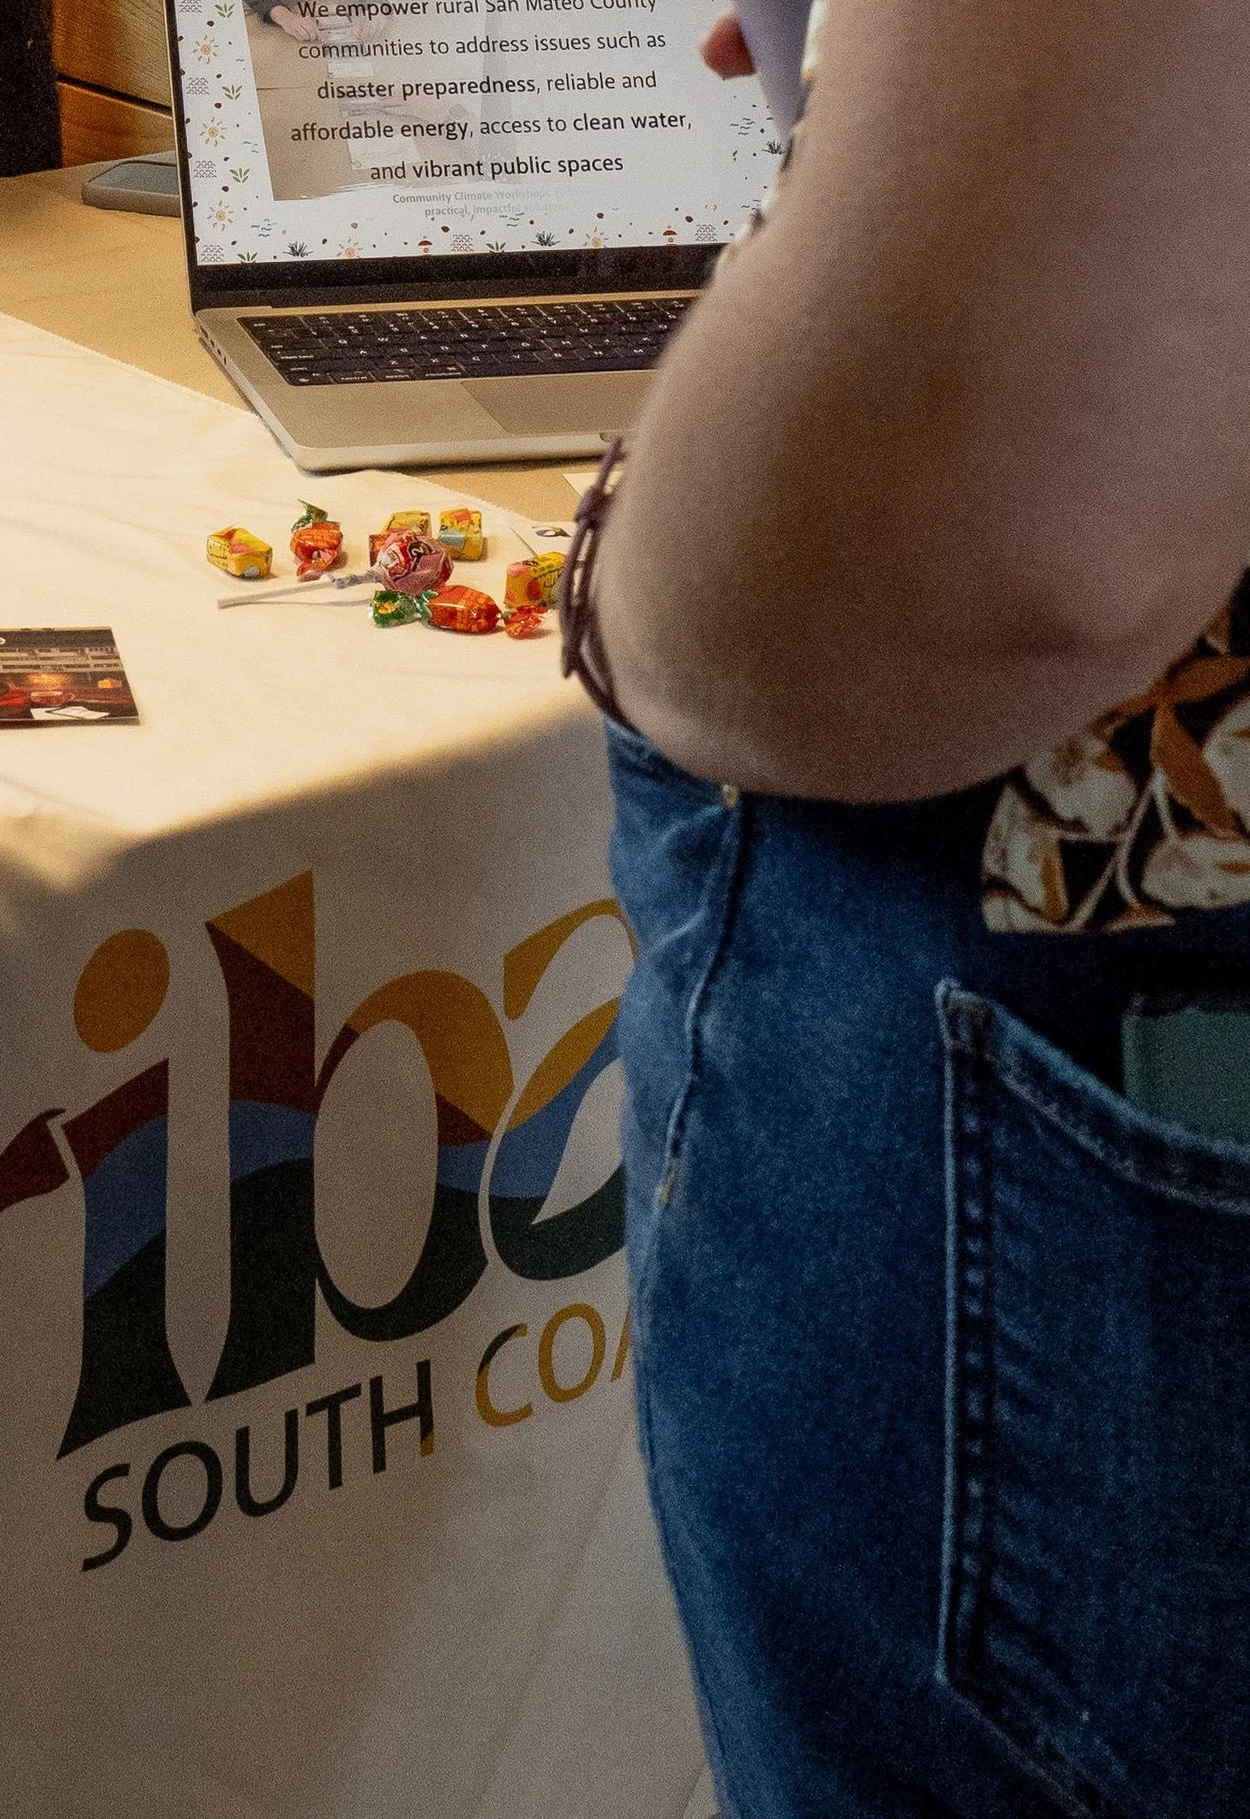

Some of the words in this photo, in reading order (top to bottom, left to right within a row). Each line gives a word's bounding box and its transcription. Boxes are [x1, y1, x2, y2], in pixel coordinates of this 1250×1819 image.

[297, 0, 329, 18] We
[335, 1, 429, 21] empower
[298, 39, 424, 59] communities
[429, 39, 450, 55] to
[455, 35, 529, 54] address
[534, 35, 591, 51] issues
[596, 31, 641, 50] such
[646, 34, 667, 48] as
[317, 81, 395, 99] disaster
[401, 76, 541, 101] preparedness,
[546, 72, 616, 92] reliable
[622, 70, 658, 89] and
[290, 120, 395, 142] affordable
[400, 121, 474, 141] energy,
[479, 119, 542, 135] access
[546, 116, 568, 132] to
[573, 113, 625, 131] clean
[630, 113, 692, 131] water,
[370, 161, 407, 180] and
[412, 159, 485, 179] vibrant
[490, 156, 552, 180] public
[557, 157, 624, 178] spaces
[392, 192, 452, 205] Community
[454, 190, 493, 201] Climate
[424, 204, 470, 218] practical,
[80, 1358, 435, 1573] SOUTH
[474, 1302, 631, 1428] CO
